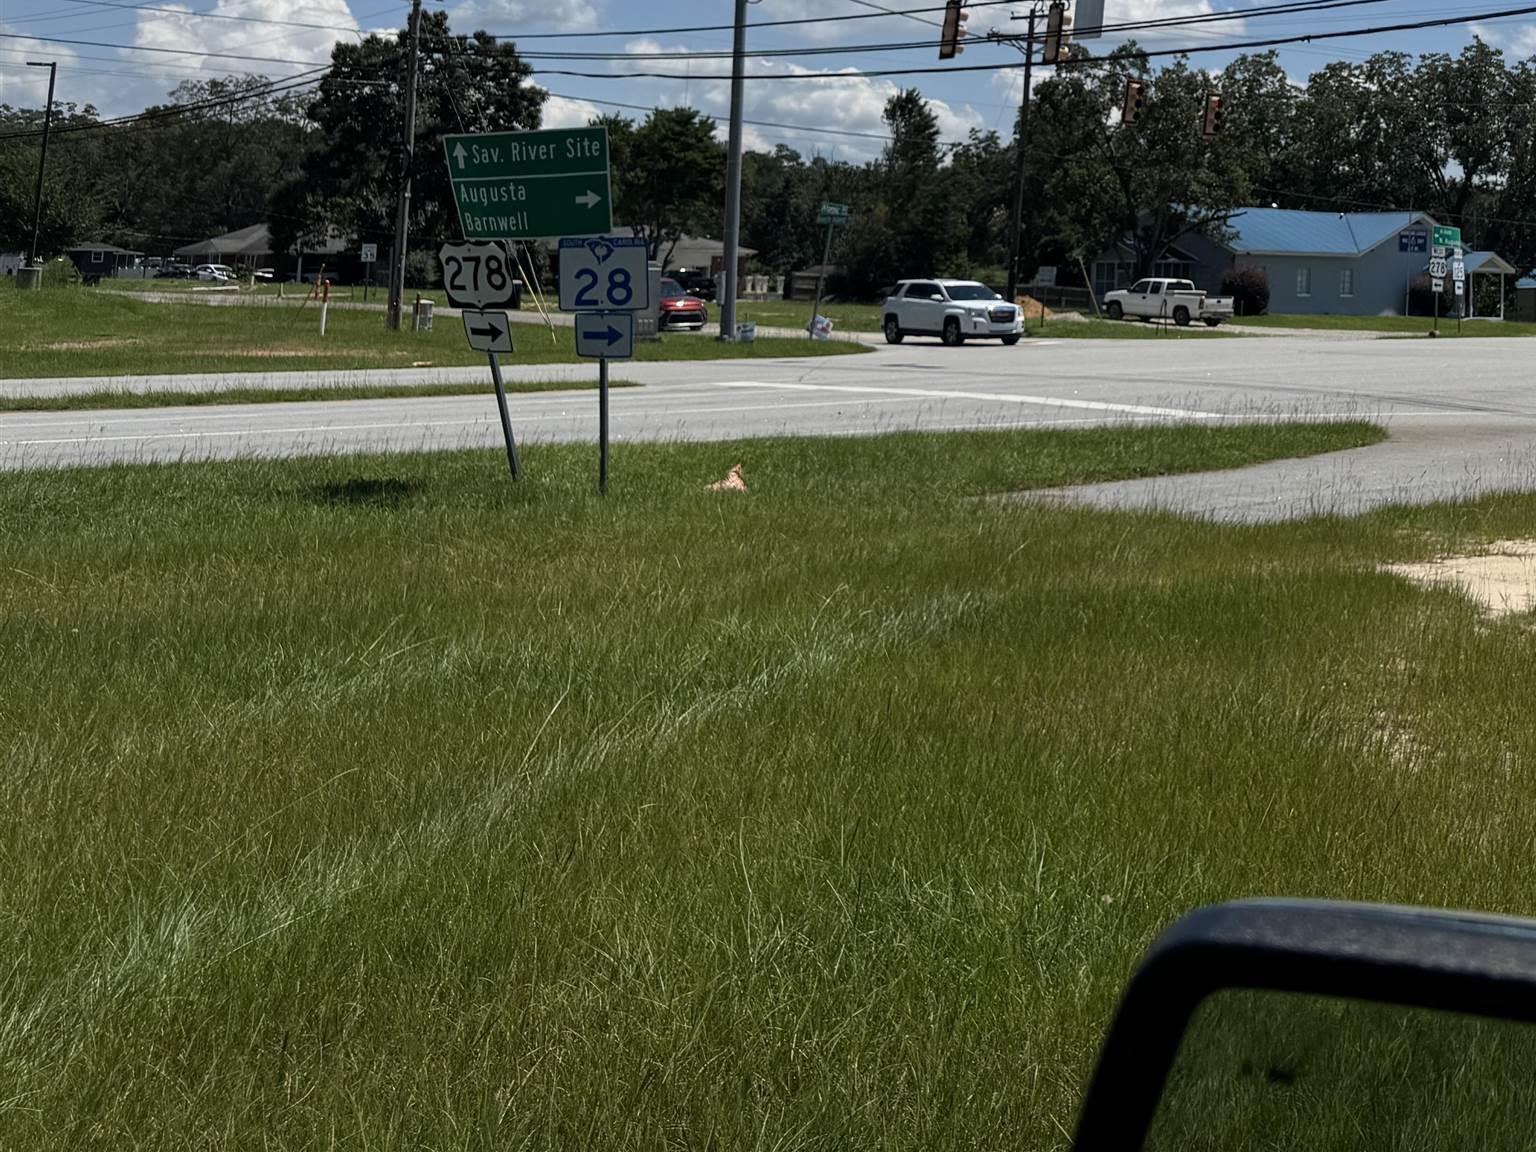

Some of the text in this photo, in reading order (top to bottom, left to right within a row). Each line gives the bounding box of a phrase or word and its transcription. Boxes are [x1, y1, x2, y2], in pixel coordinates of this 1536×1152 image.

[472, 137, 600, 165] Sav. River Site
[460, 182, 527, 206] Augusta
[464, 211, 529, 231] Barnwell
[563, 239, 583, 247] SOUTH
[444, 255, 507, 292] 278
[1431, 261, 1446, 274] 278
[574, 267, 633, 307] 28
